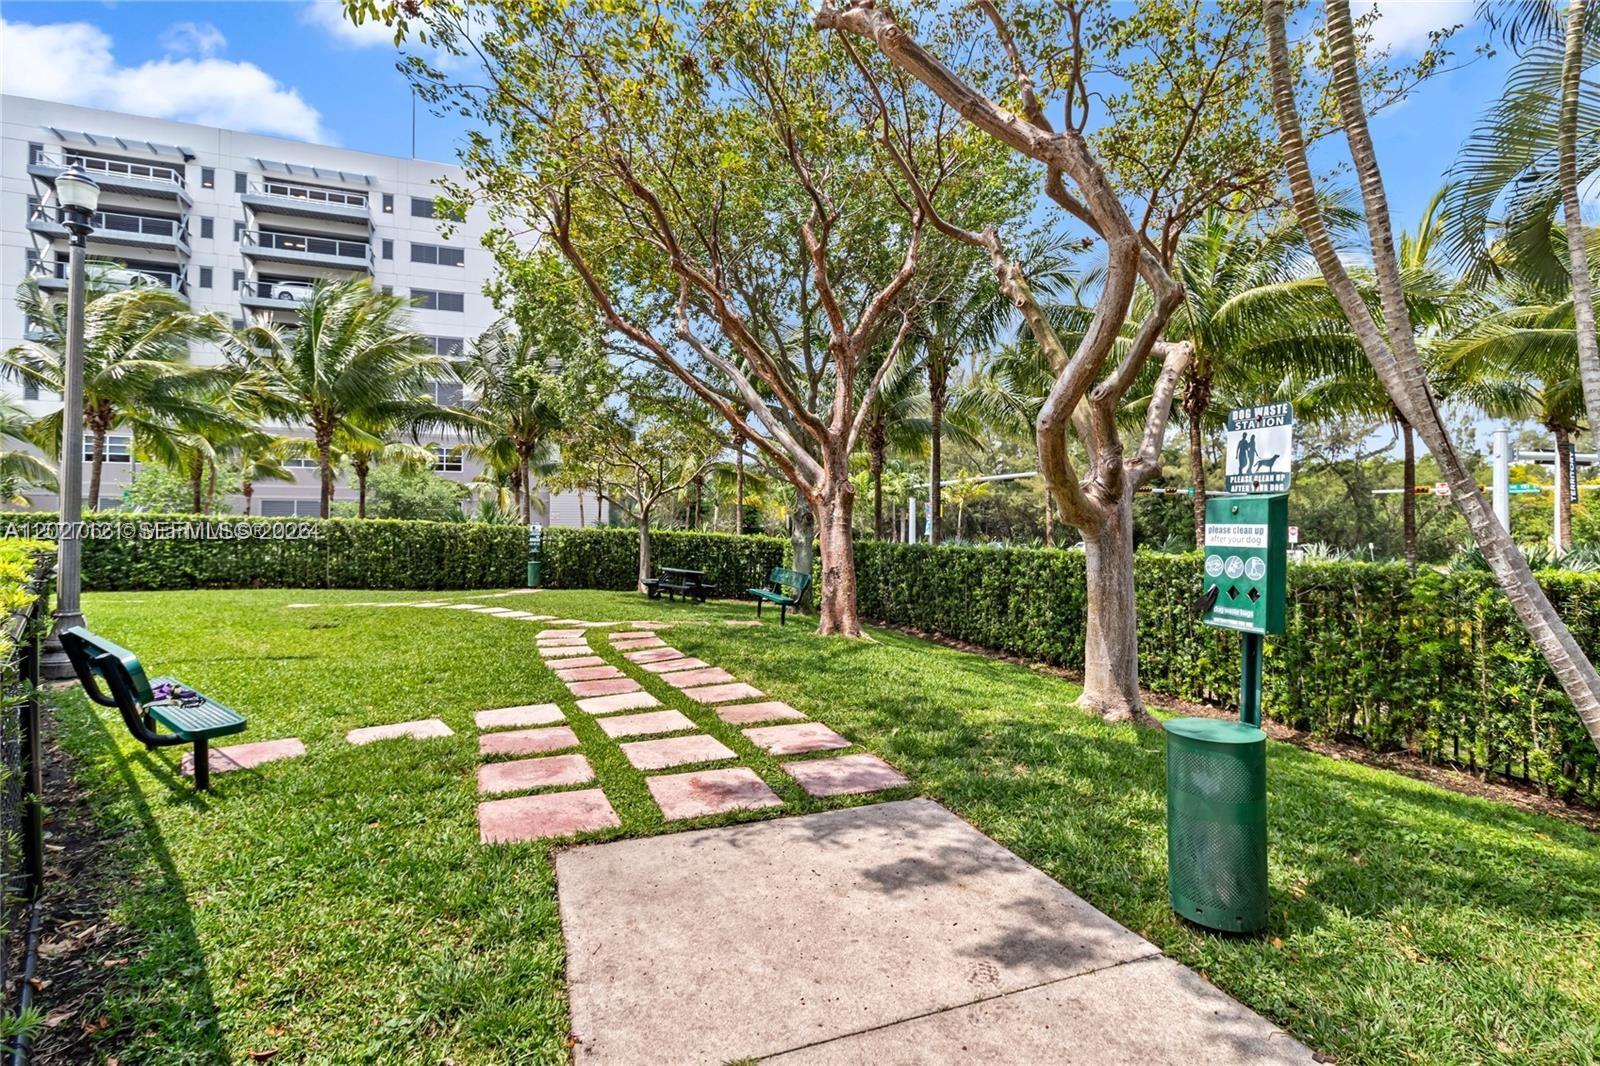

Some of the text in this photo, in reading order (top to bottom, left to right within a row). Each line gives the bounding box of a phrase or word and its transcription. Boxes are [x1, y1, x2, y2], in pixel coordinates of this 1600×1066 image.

[1232, 403, 1288, 420] DOG WASTE
[1230, 473, 1286, 484] PLEASE CLEAN UP
[1230, 484, 1250, 493] AFTER
[1269, 483, 1285, 492] DOG
[1208, 526, 1265, 536] please clean up
[1210, 535, 1262, 546] after your dog
